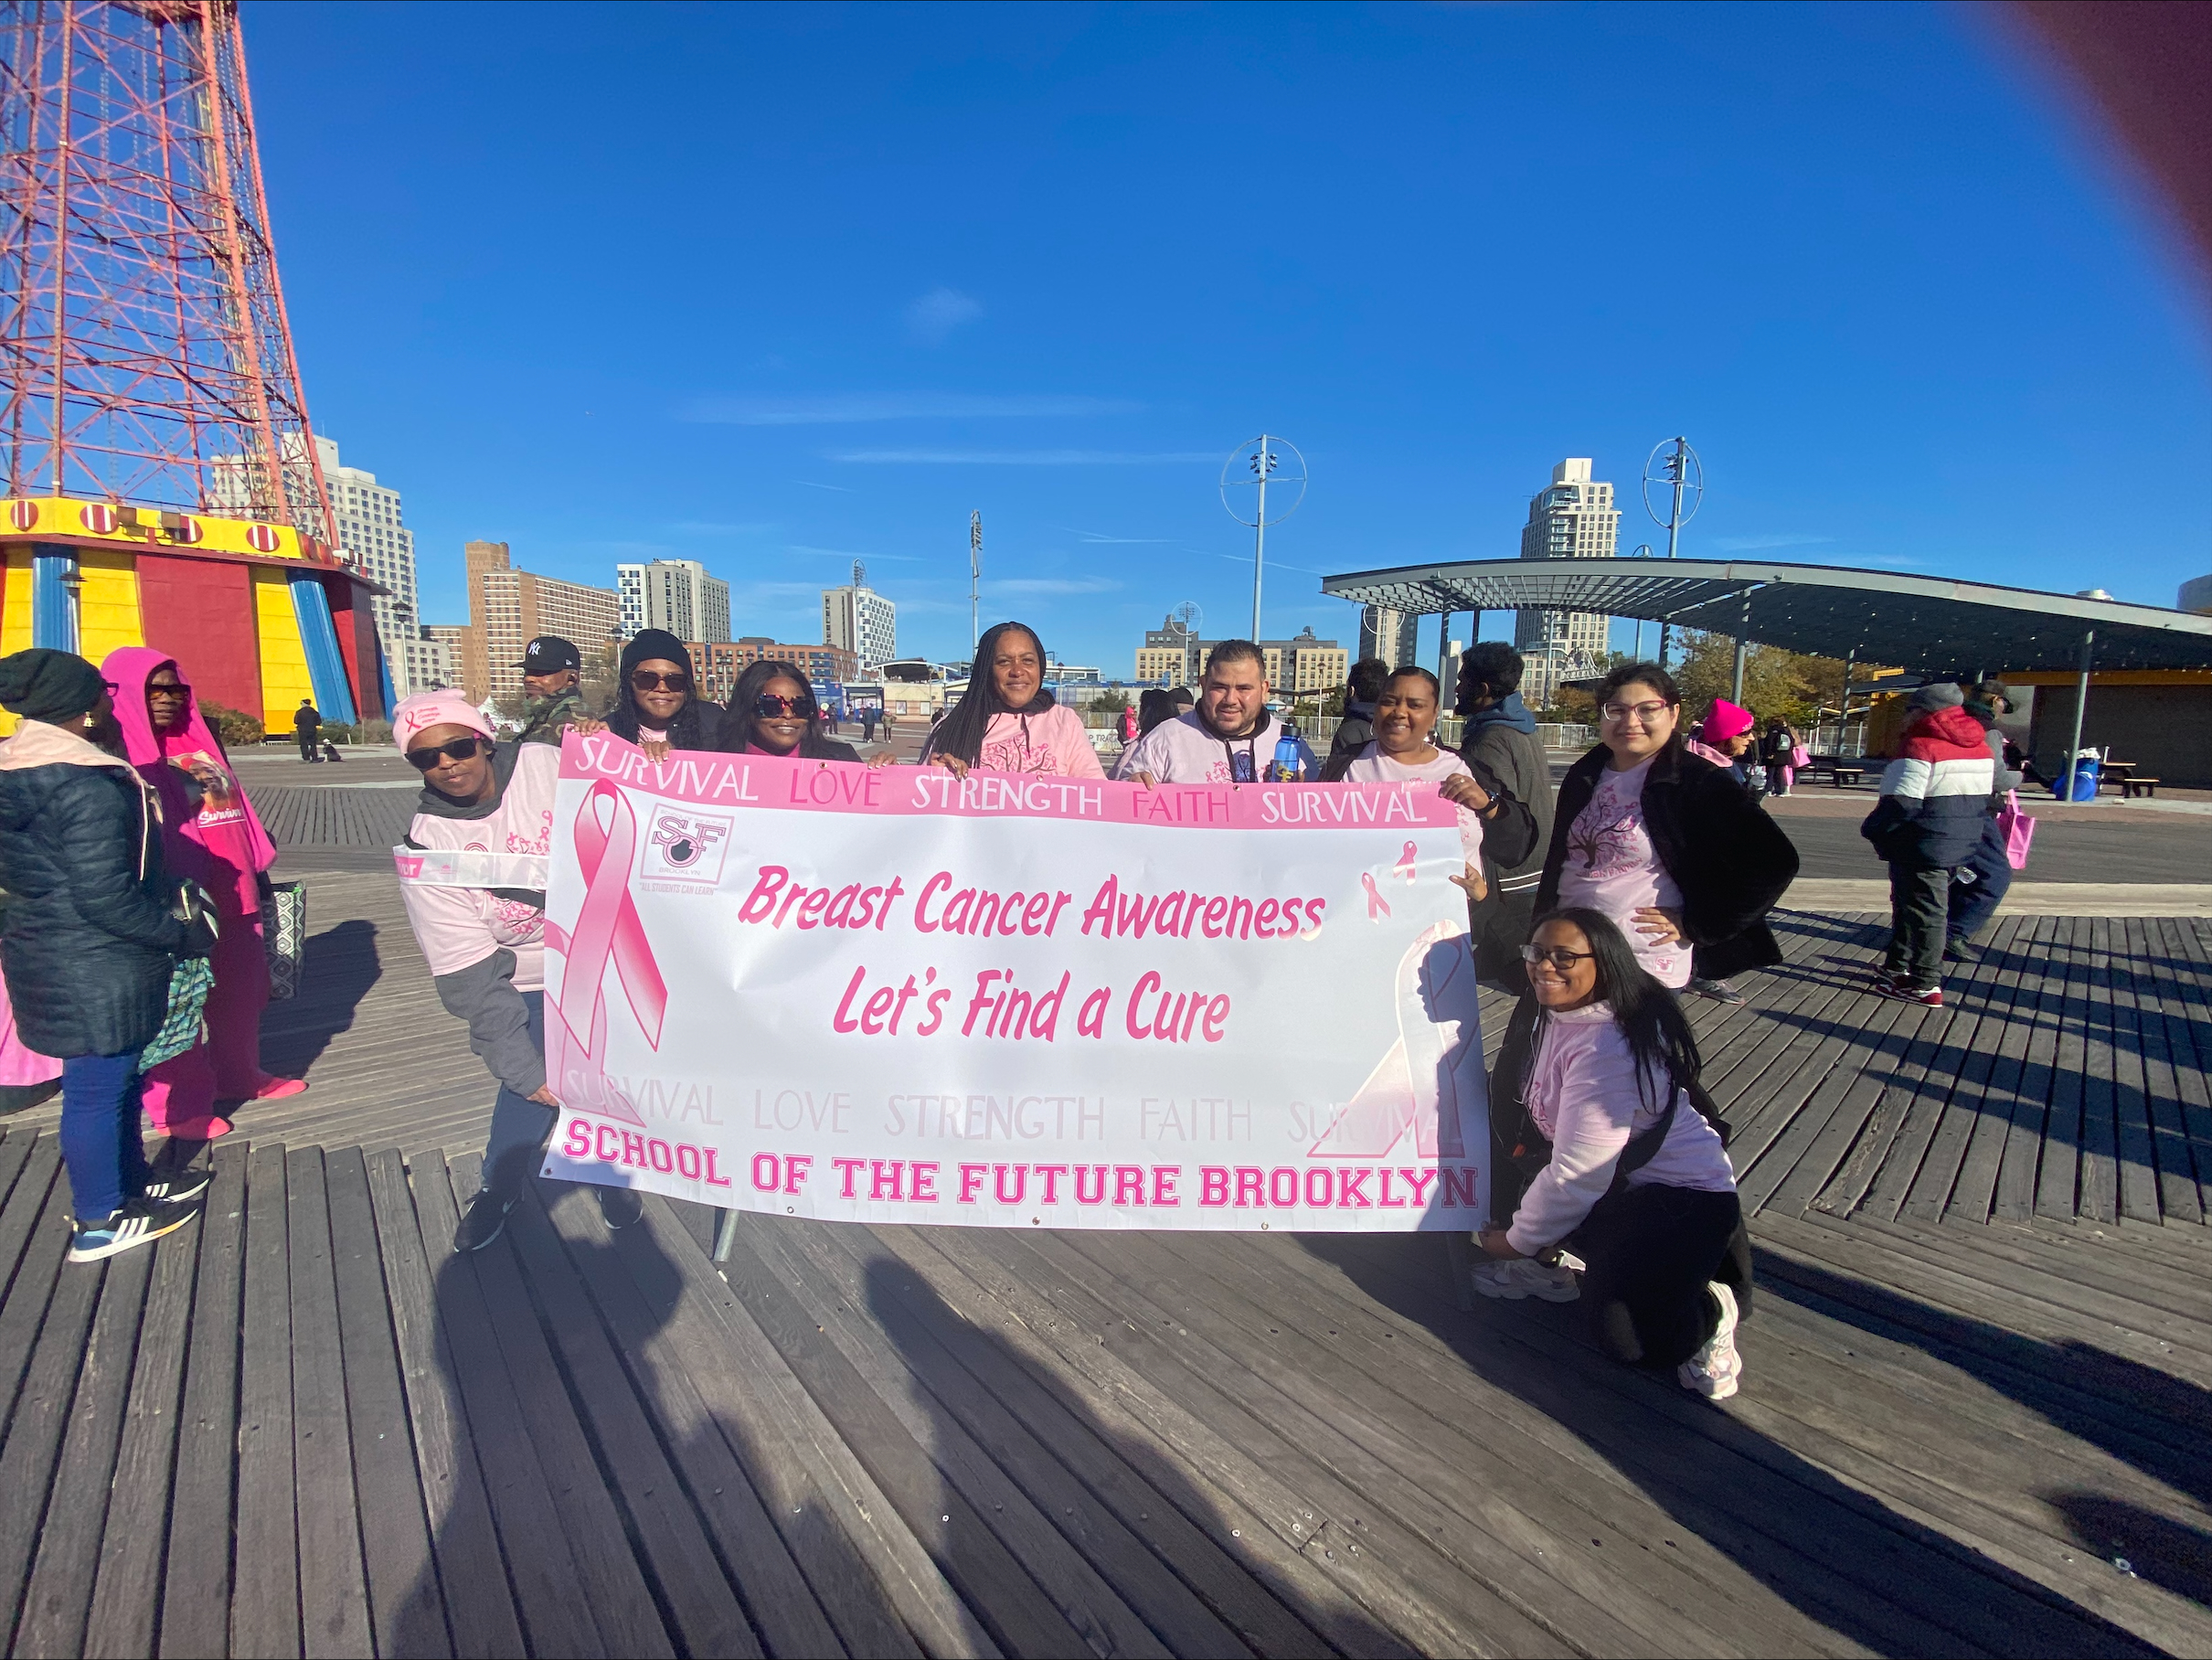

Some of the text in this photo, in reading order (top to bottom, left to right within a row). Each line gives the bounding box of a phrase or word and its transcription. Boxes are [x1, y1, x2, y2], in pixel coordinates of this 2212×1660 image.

[575, 737, 1427, 823] SURVIVAL LOVE STRENGTH FAITH SURVIVAL
[652, 883, 680, 893] STUDENTS
[681, 885, 695, 894] CAN
[658, 867, 701, 876] BROOKLYN
[738, 865, 1326, 942] Breast Cancer Awareness
[834, 965, 1231, 1043] Let's Find a Cure
[566, 1069, 724, 1125] SURVIVAL
[753, 1089, 851, 1133] LOVE
[884, 1093, 1105, 1141] STRENGTH
[1139, 1097, 1251, 1142] FAITH
[561, 1117, 1479, 1209] SCHOOL OF THE FUTURE BROOKLYN
